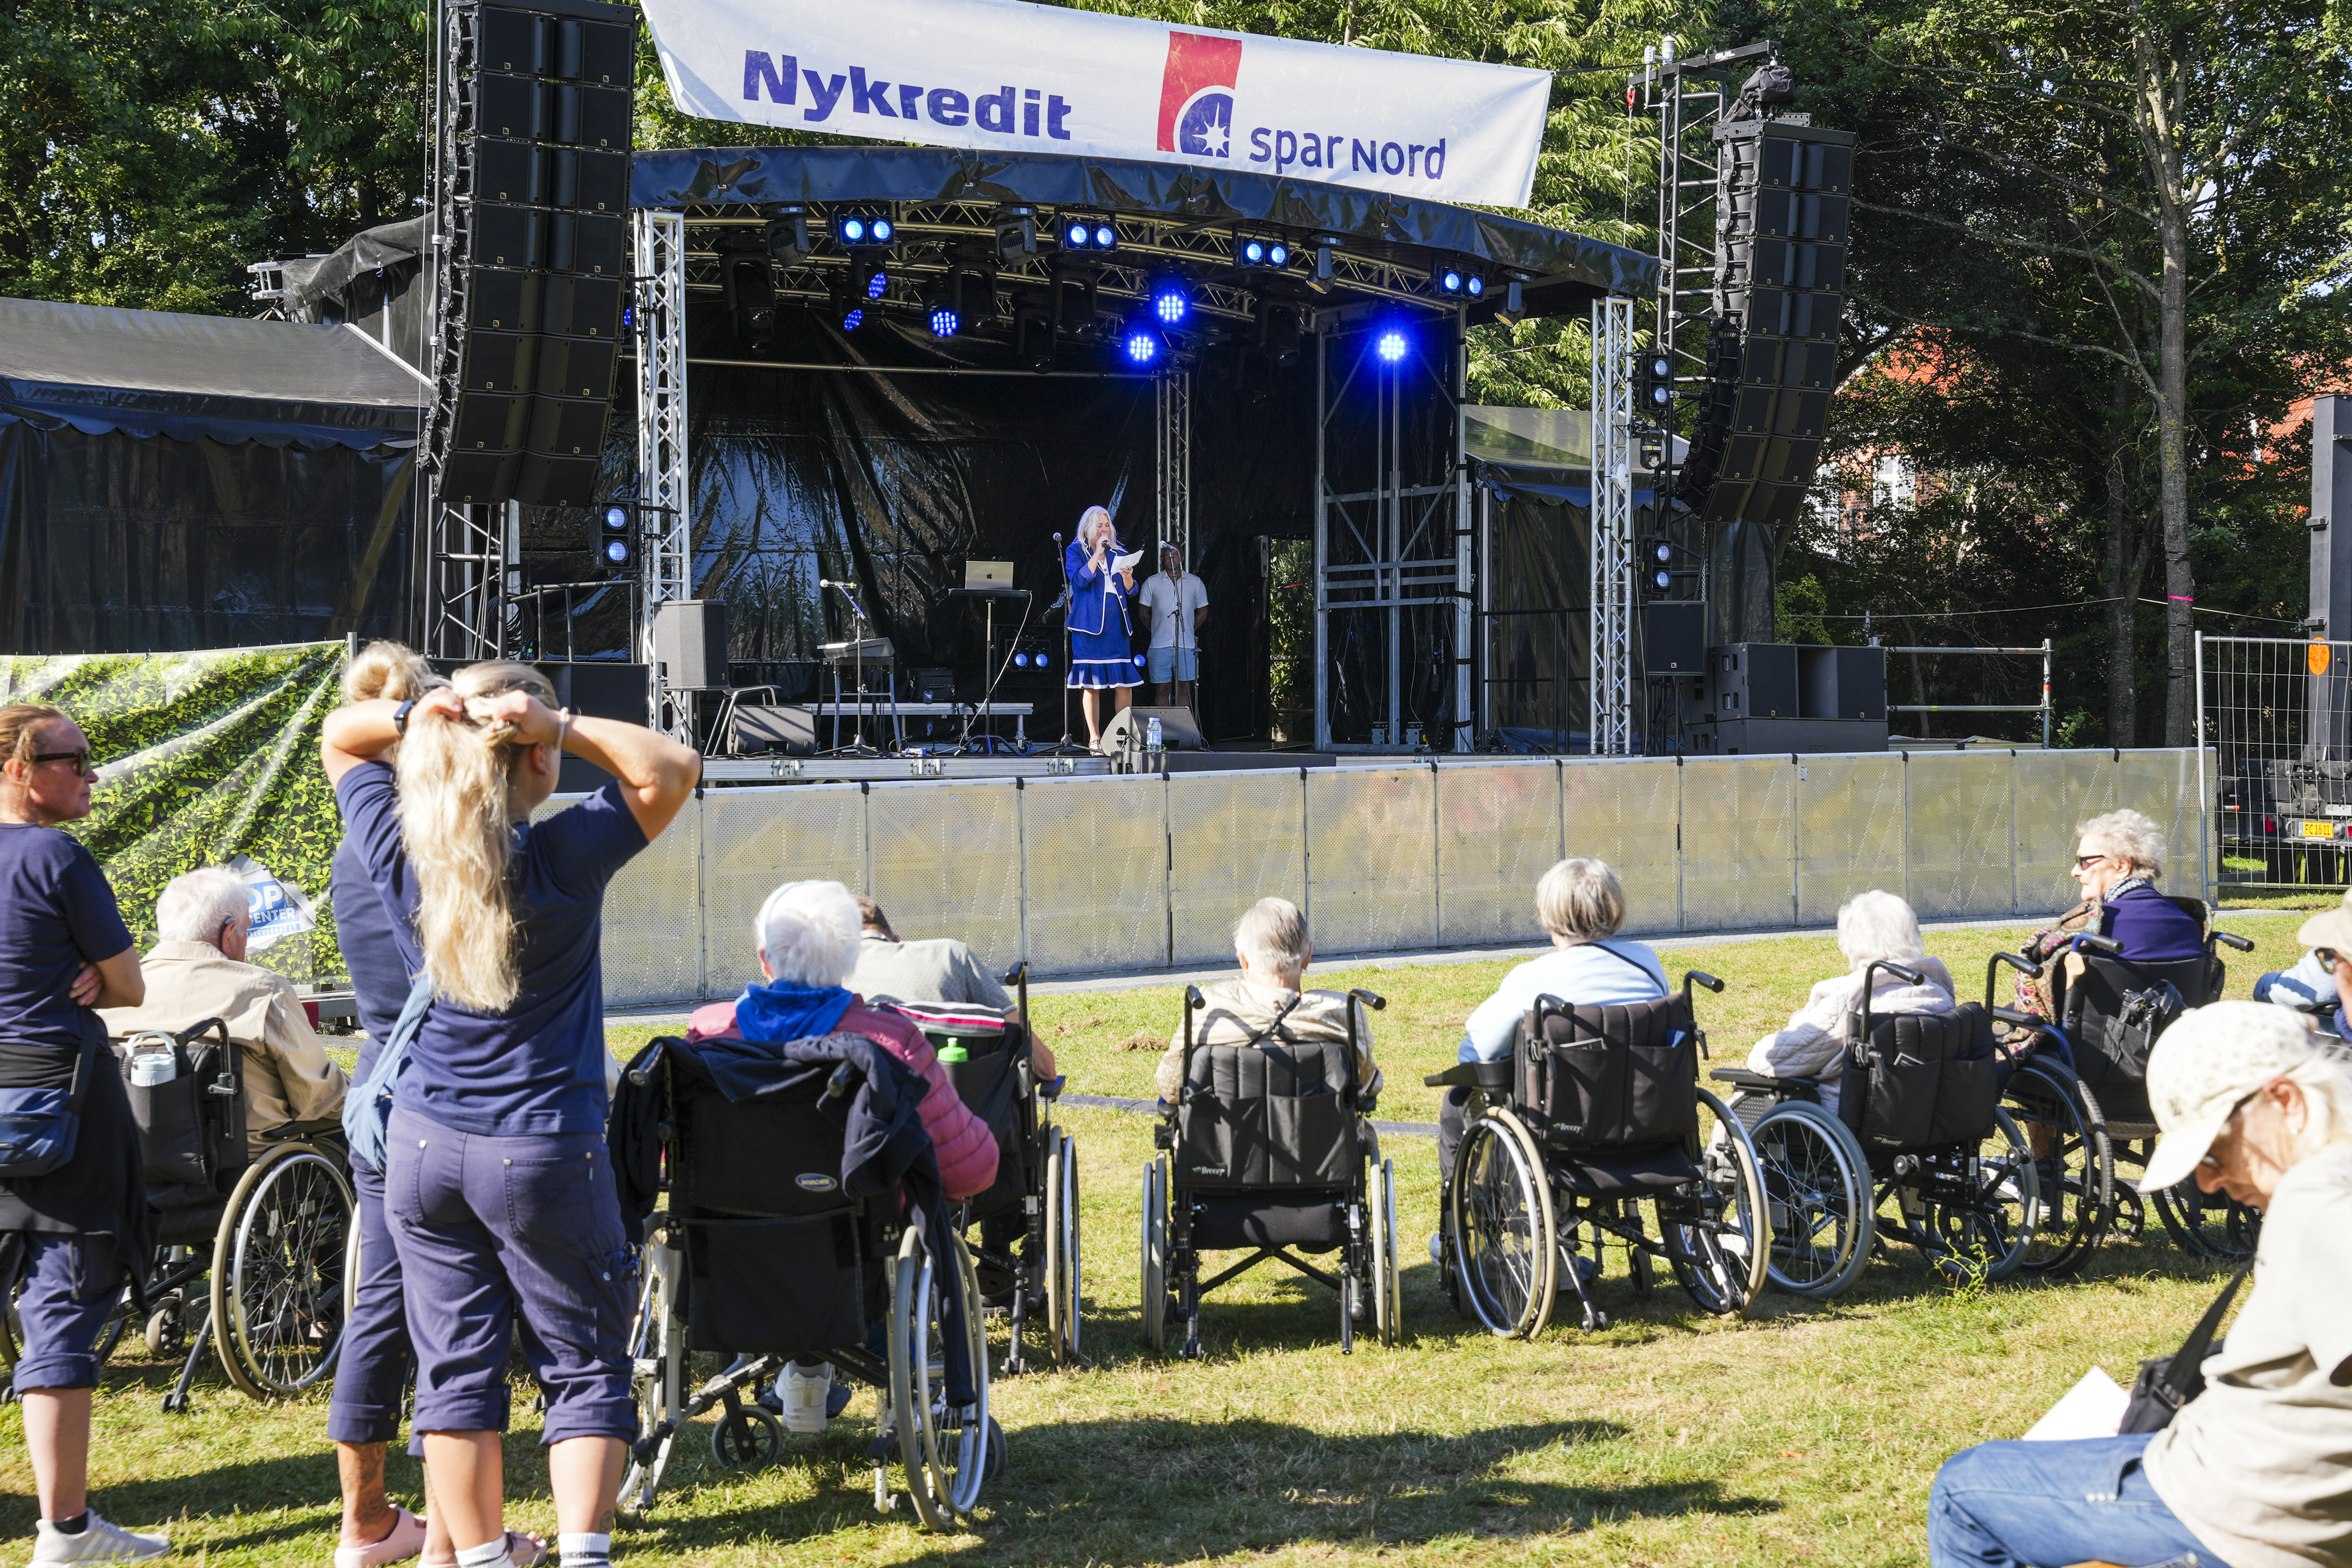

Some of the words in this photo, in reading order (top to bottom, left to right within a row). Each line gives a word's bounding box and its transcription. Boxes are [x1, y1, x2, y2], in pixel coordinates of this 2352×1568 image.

[744, 50, 1071, 141] Nykredit
[1352, 137, 1446, 180] Nord
[1560, 1123, 1582, 1133] Breezy
[1881, 1138, 1903, 1146] Breezy
[1202, 1166, 1225, 1177] Breezy
